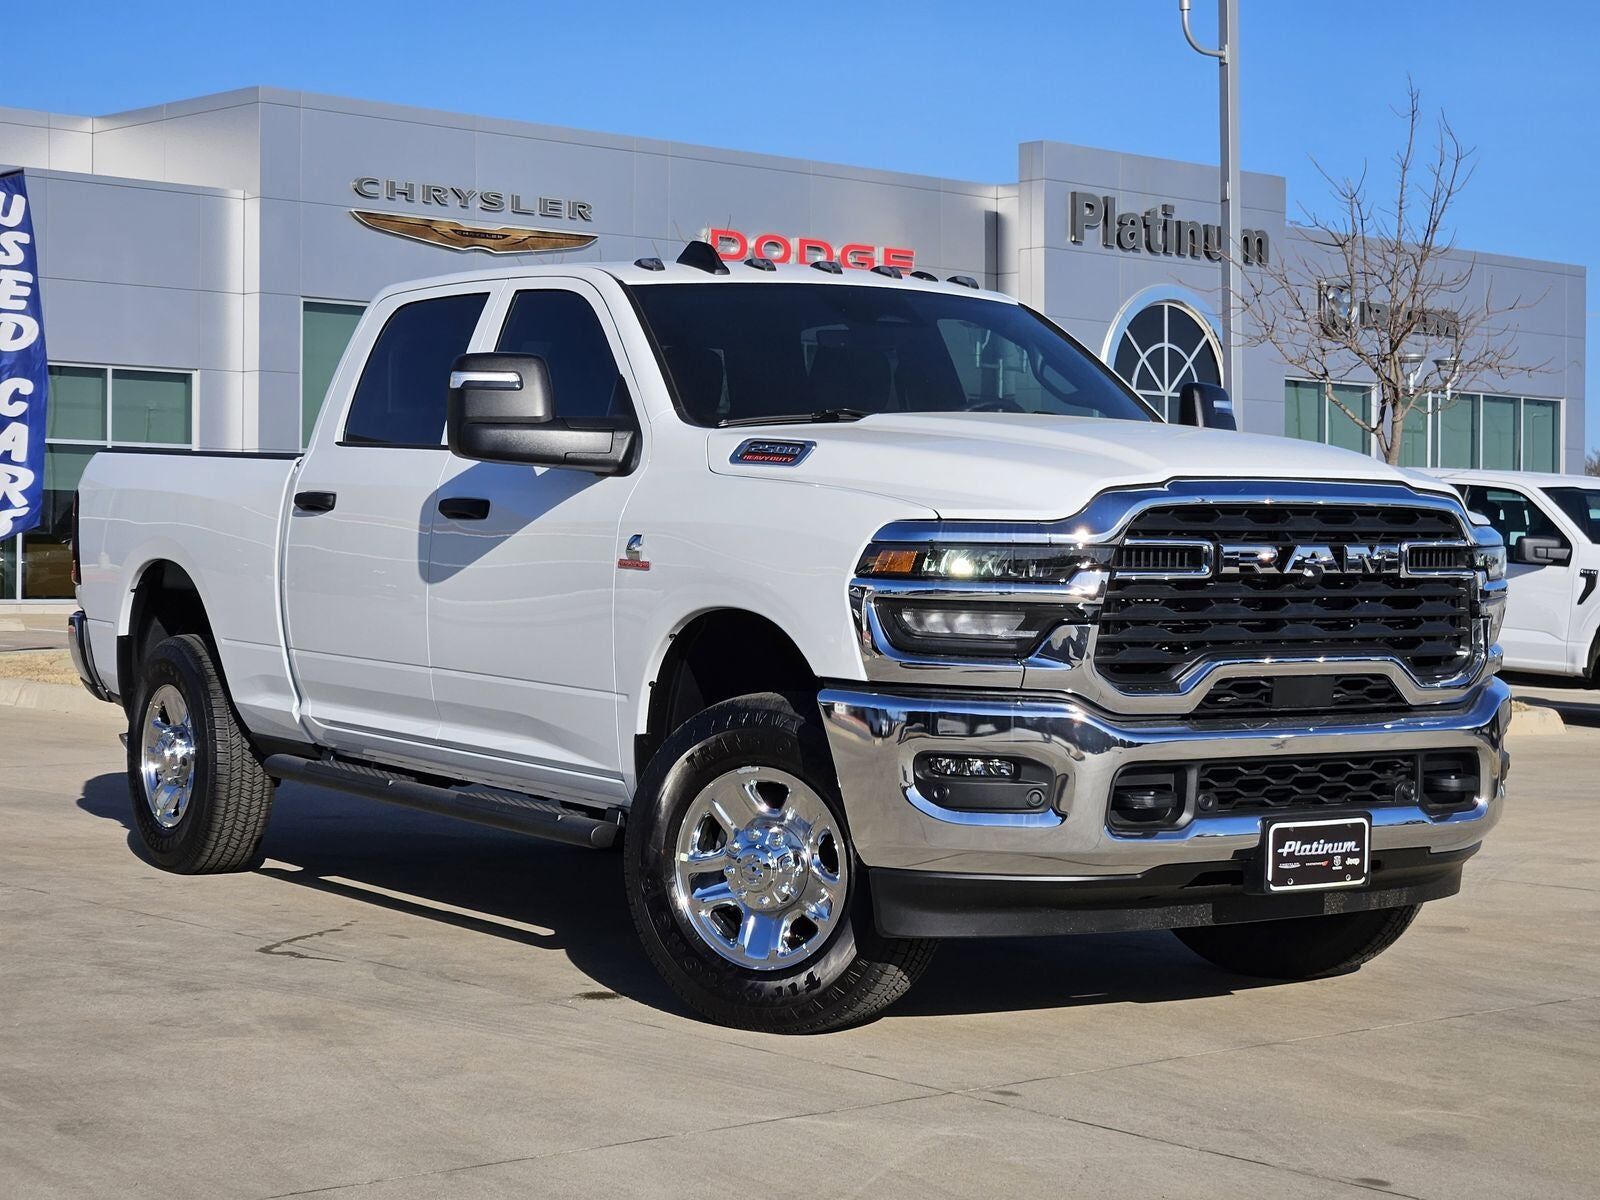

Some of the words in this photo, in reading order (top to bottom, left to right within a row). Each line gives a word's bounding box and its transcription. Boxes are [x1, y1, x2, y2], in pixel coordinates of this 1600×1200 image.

[351, 176, 593, 221] CHRYSLER
[708, 227, 916, 276] DODGE
[1069, 191, 1269, 266] Platinum
[0, 191, 40, 352] USED
[1219, 544, 1400, 575] RAM
[1277, 839, 1361, 857] Platinum
